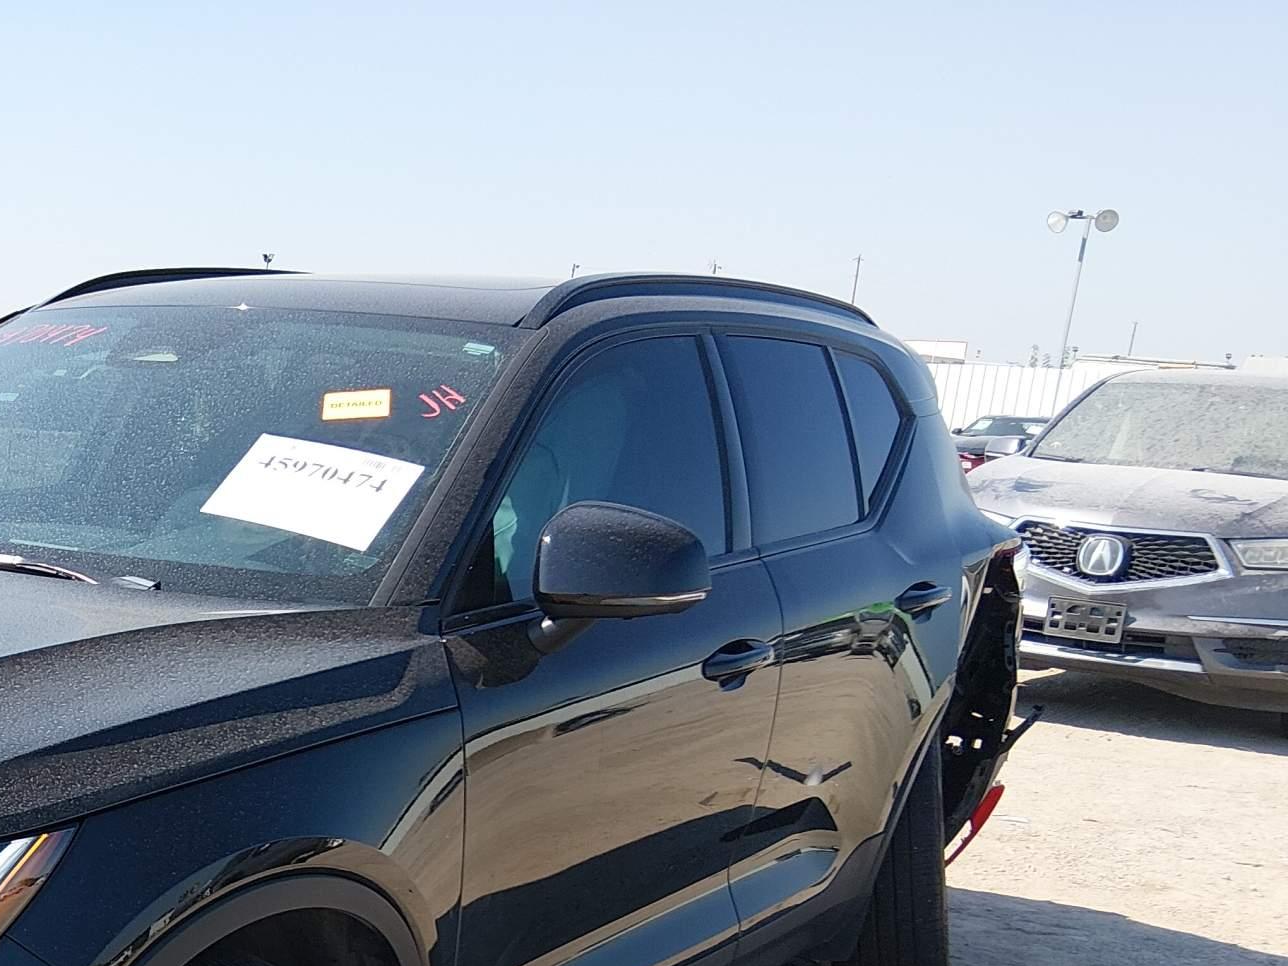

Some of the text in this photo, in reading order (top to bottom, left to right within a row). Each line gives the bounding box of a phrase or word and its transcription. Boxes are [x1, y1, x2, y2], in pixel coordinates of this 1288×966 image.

[330, 399, 383, 409] DETAILED
[418, 384, 467, 418] JH
[258, 455, 388, 493] 45970474
